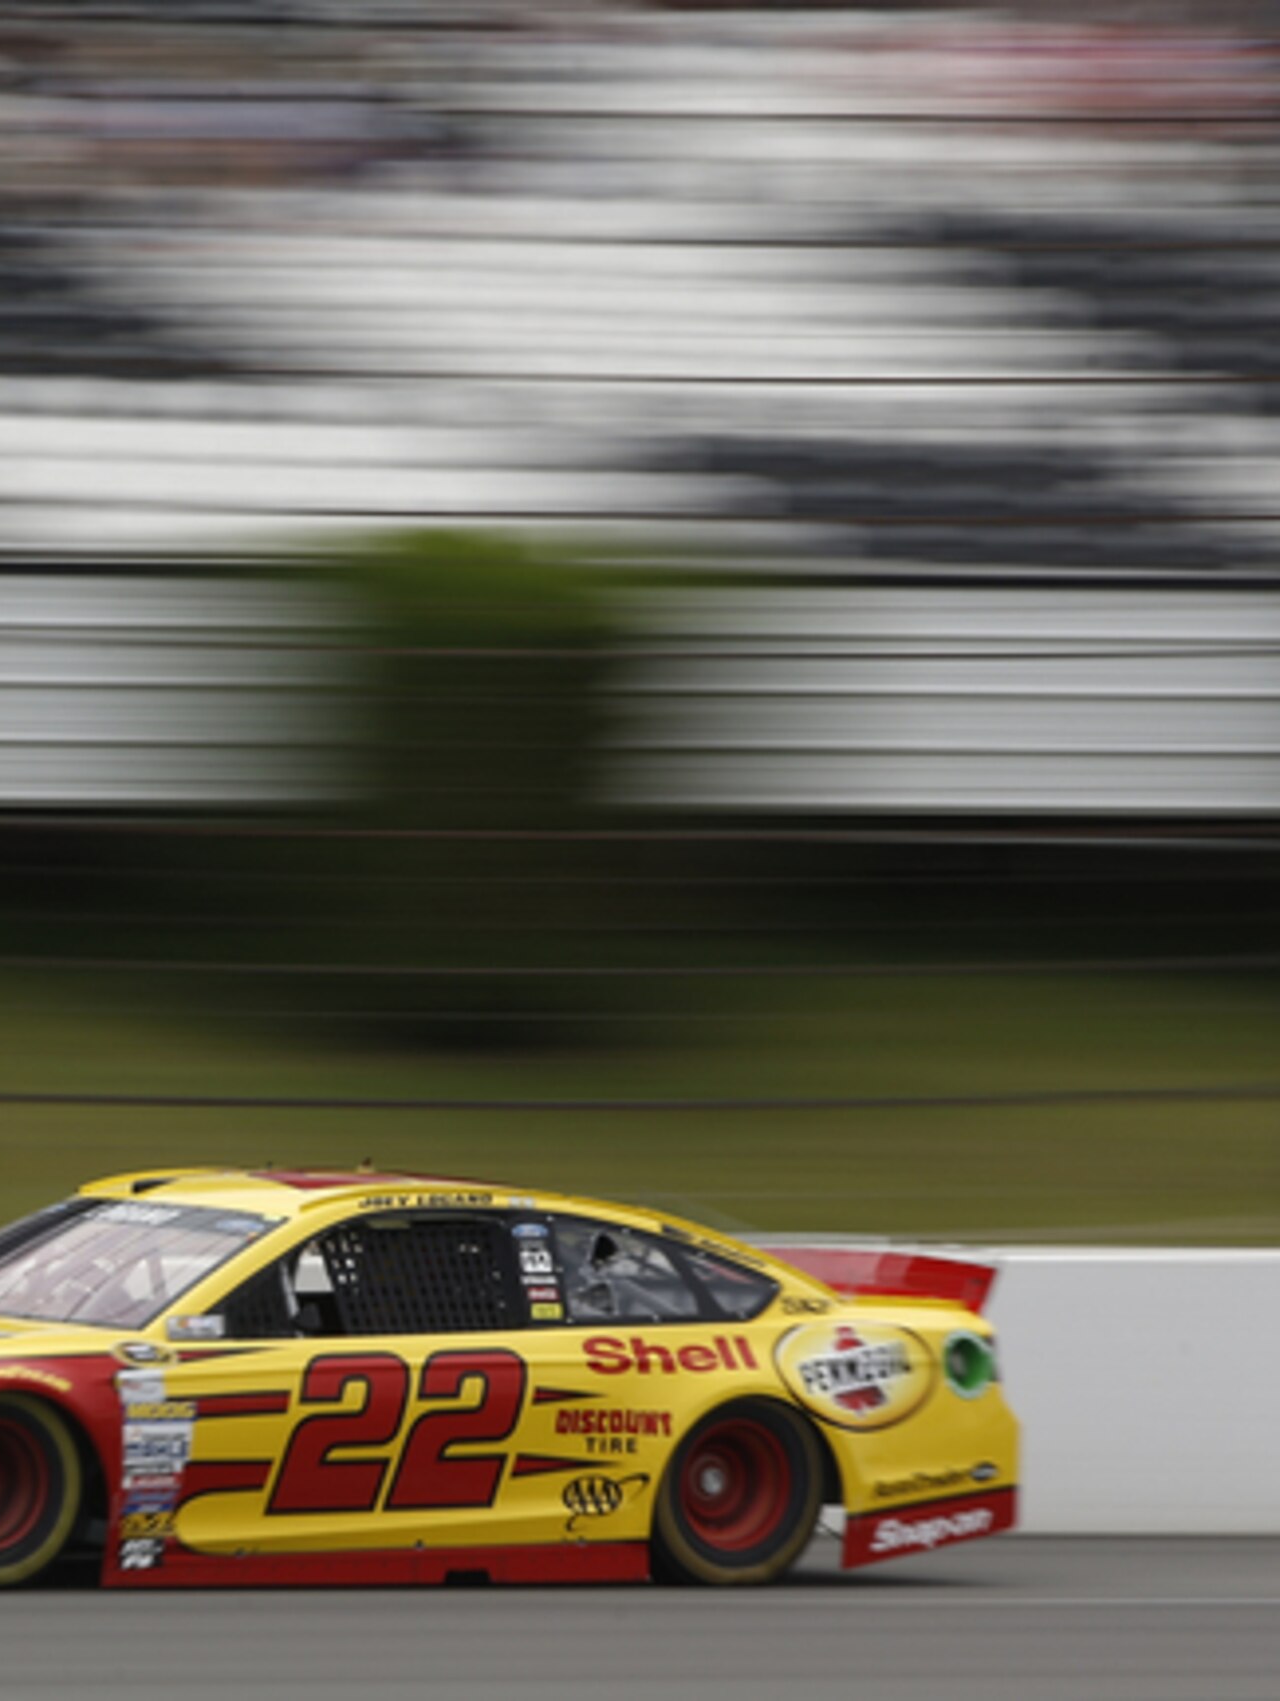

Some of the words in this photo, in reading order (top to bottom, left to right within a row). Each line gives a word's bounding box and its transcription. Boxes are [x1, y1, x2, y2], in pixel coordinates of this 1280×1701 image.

[582, 1335, 760, 1376] Shell
[263, 1346, 528, 1516] 22
[554, 1408, 673, 1437] DISCOUNT
[585, 1436, 638, 1454] TIRE
